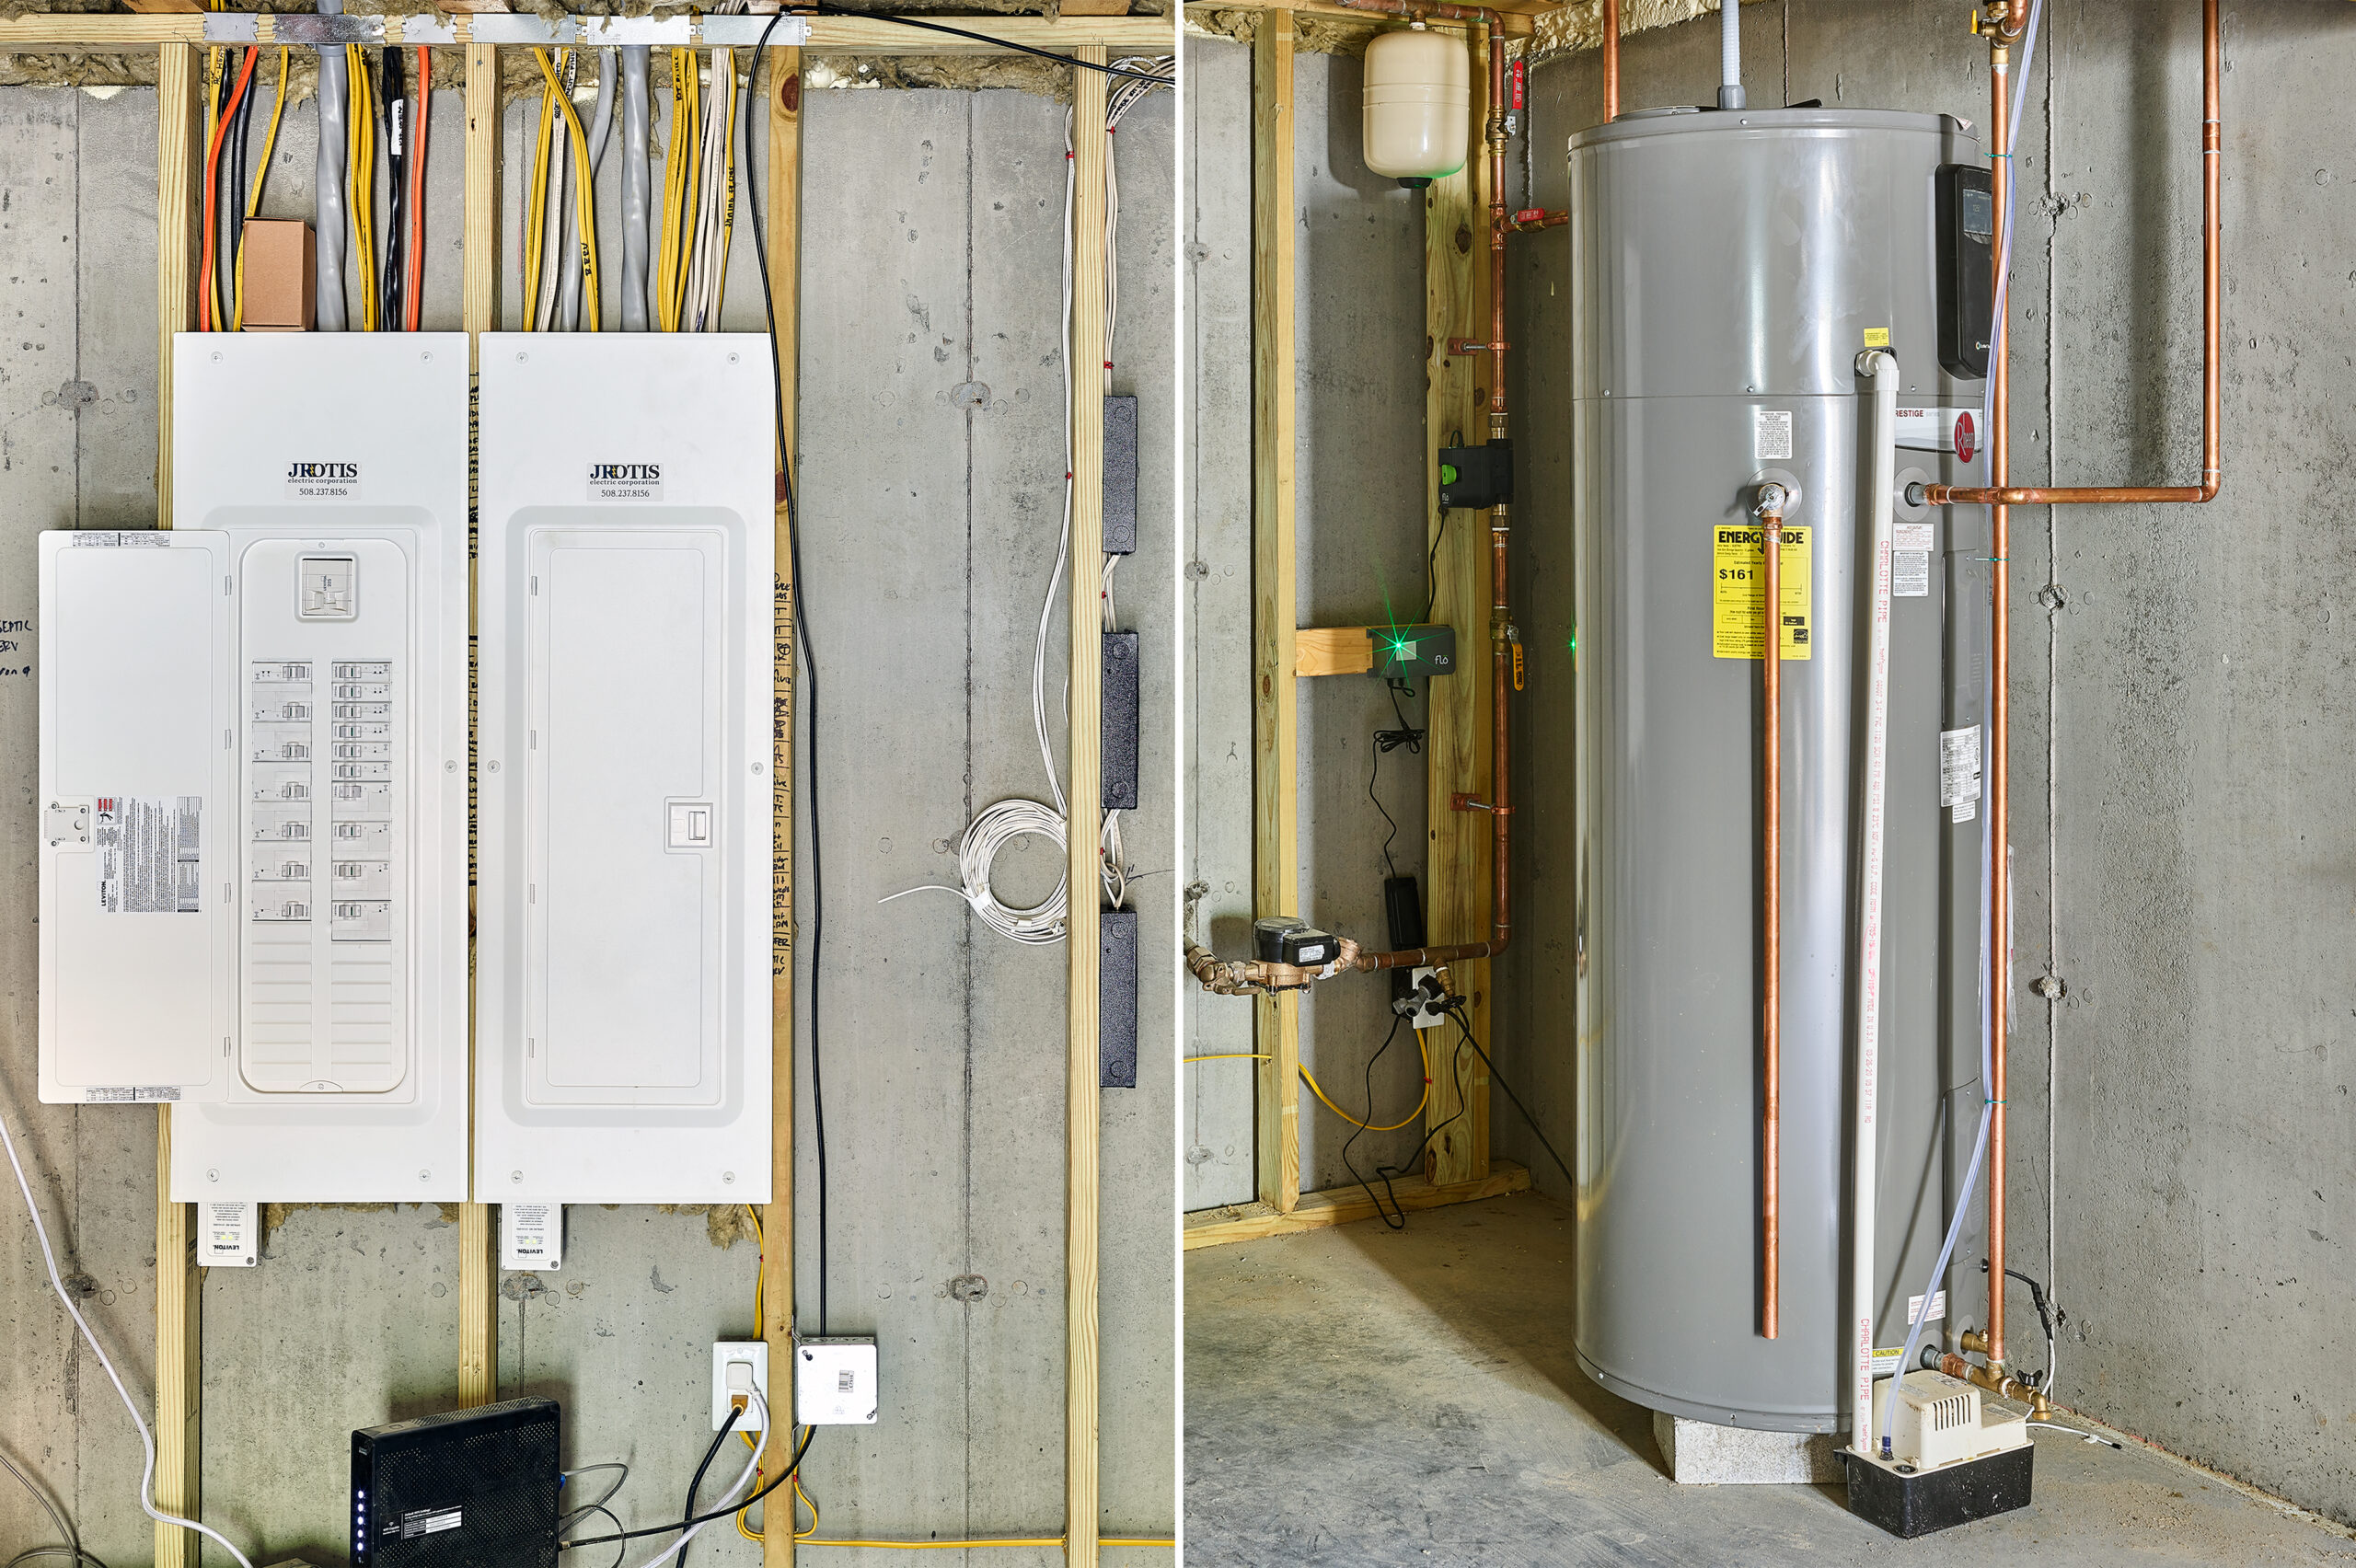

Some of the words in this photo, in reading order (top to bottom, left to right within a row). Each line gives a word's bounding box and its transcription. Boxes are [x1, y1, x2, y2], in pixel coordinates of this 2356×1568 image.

[299, 488, 348, 496] 508.237.8156
[601, 490, 650, 498] 508.237.8156
[1719, 569, 1753, 580] $161
[1878, 540, 1889, 595] CHARLOTTE
[1877, 600, 1888, 623] PIPE
[1860, 1318, 1870, 1371] CHARLOTTE
[1860, 1377, 1870, 1401] PIPE
